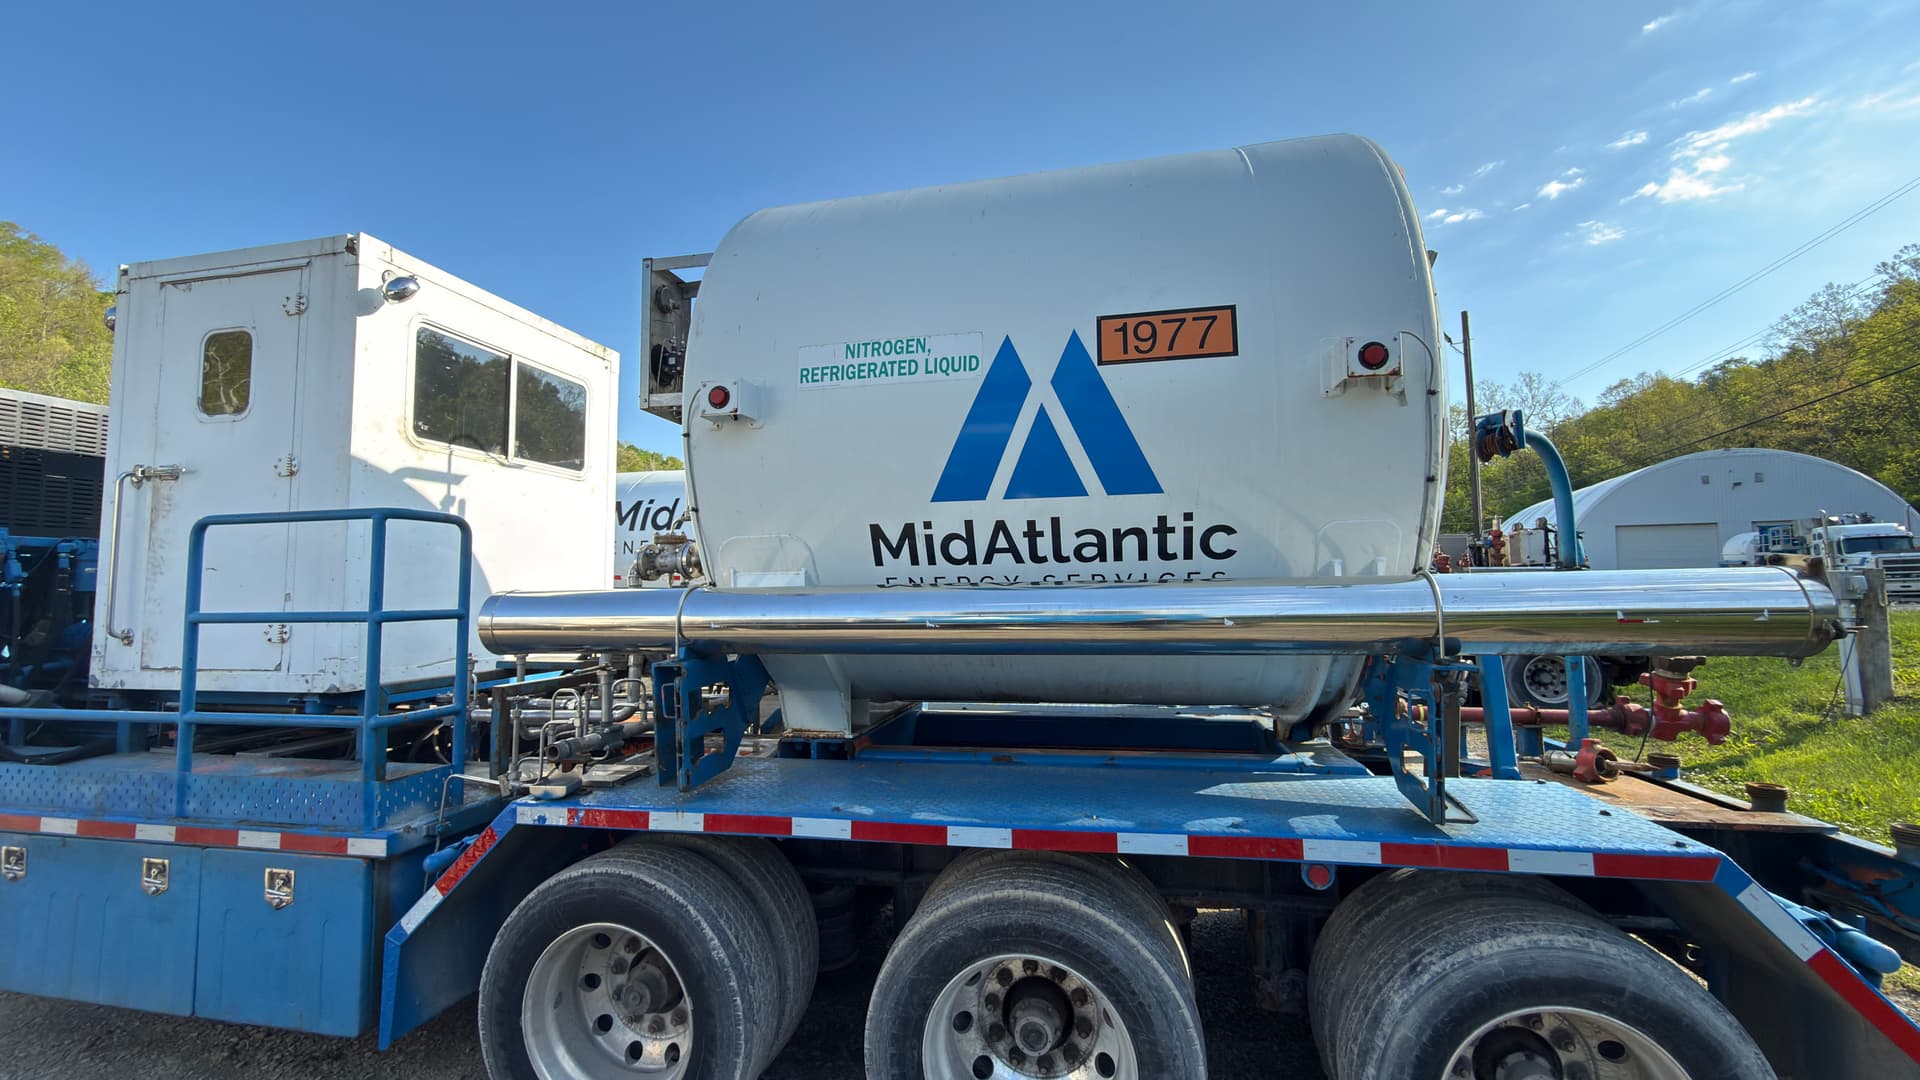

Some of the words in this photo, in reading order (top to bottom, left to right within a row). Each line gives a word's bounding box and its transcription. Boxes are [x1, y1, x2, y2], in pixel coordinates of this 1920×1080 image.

[845, 337, 932, 360] NITROGEN,
[1113, 315, 1218, 355] 1977
[799, 359, 919, 384] REFRIGERATED
[924, 354, 980, 376] LIQUID
[615, 497, 686, 532] Mid
[868, 511, 1238, 568] MidAtlantic
